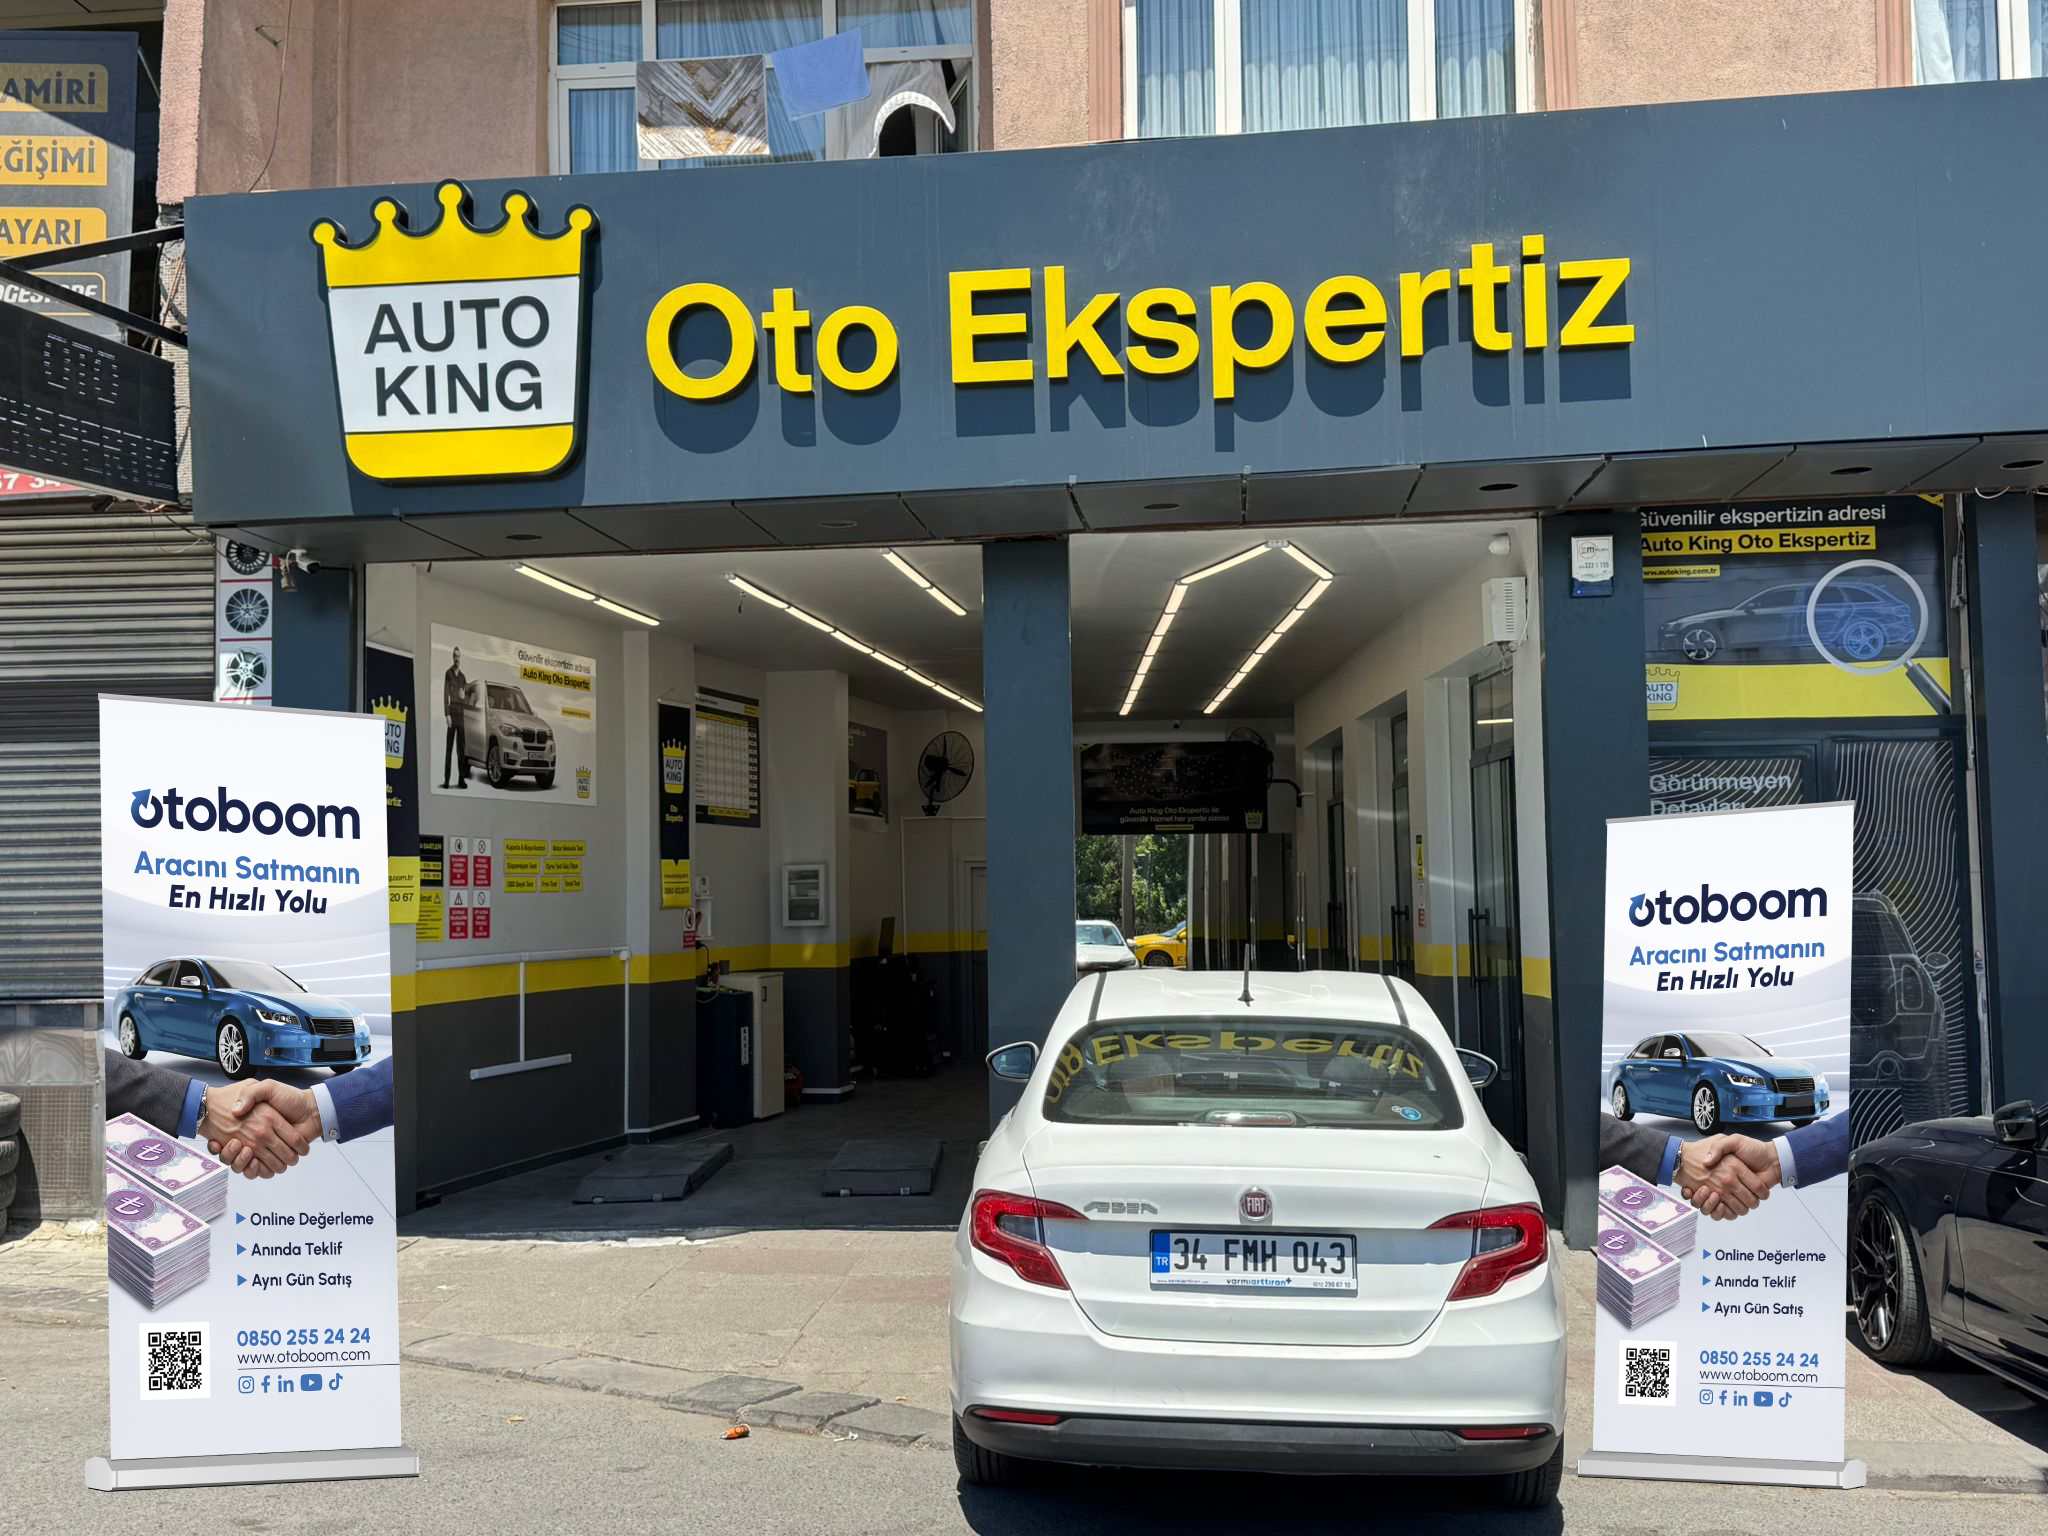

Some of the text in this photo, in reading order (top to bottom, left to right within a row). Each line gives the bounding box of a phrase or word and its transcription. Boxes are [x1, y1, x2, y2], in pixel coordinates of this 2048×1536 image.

[0, 139, 96, 180] ĞİŞİMİ
[0, 217, 82, 245] AYARI
[364, 295, 551, 356] AUTO
[645, 233, 1636, 401] Oto Ekspertiz
[374, 360, 543, 418] KING
[0, 472, 20, 490] 7
[1719, 506, 1824, 527] ekspertizin
[1828, 504, 1887, 522] adresi
[1641, 530, 1872, 554] Auto King Oto Ekspertiz
[385, 724, 402, 738] UTO
[385, 740, 400, 753] ING
[665, 758, 683, 771] AUTO
[666, 771, 683, 783] KING
[1650, 773, 1792, 795] Görünmeyen
[130, 786, 361, 840] otoboom
[134, 850, 361, 884] Aracını Satmanın
[168, 884, 328, 915] En Hızlı Yolu
[1628, 884, 1828, 928] otoboom
[1629, 941, 1826, 967] Aracını Satmanın
[1656, 965, 1795, 992] En Hızlı Yolu
[1246, 1195, 1266, 1212] FIAT
[249, 1211, 375, 1229] Online Değerleme
[251, 1240, 343, 1258] Anında Teklif
[1173, 1237, 1347, 1275] 34 FMH 043
[1714, 1248, 1827, 1265] Online Değerleme
[1156, 1256, 1169, 1267] TR
[251, 1272, 353, 1291] Aynı Gün Satış
[1714, 1274, 1797, 1289] Anında Teklif
[1713, 1301, 1804, 1318] Aynı Gün Satış
[236, 1327, 371, 1347] 0850 255 24 24
[236, 1348, 371, 1366] www.otoboom.com
[1699, 1350, 1820, 1368] 0850 255 24 24
[1699, 1369, 1819, 1384] www.otoboom.com
